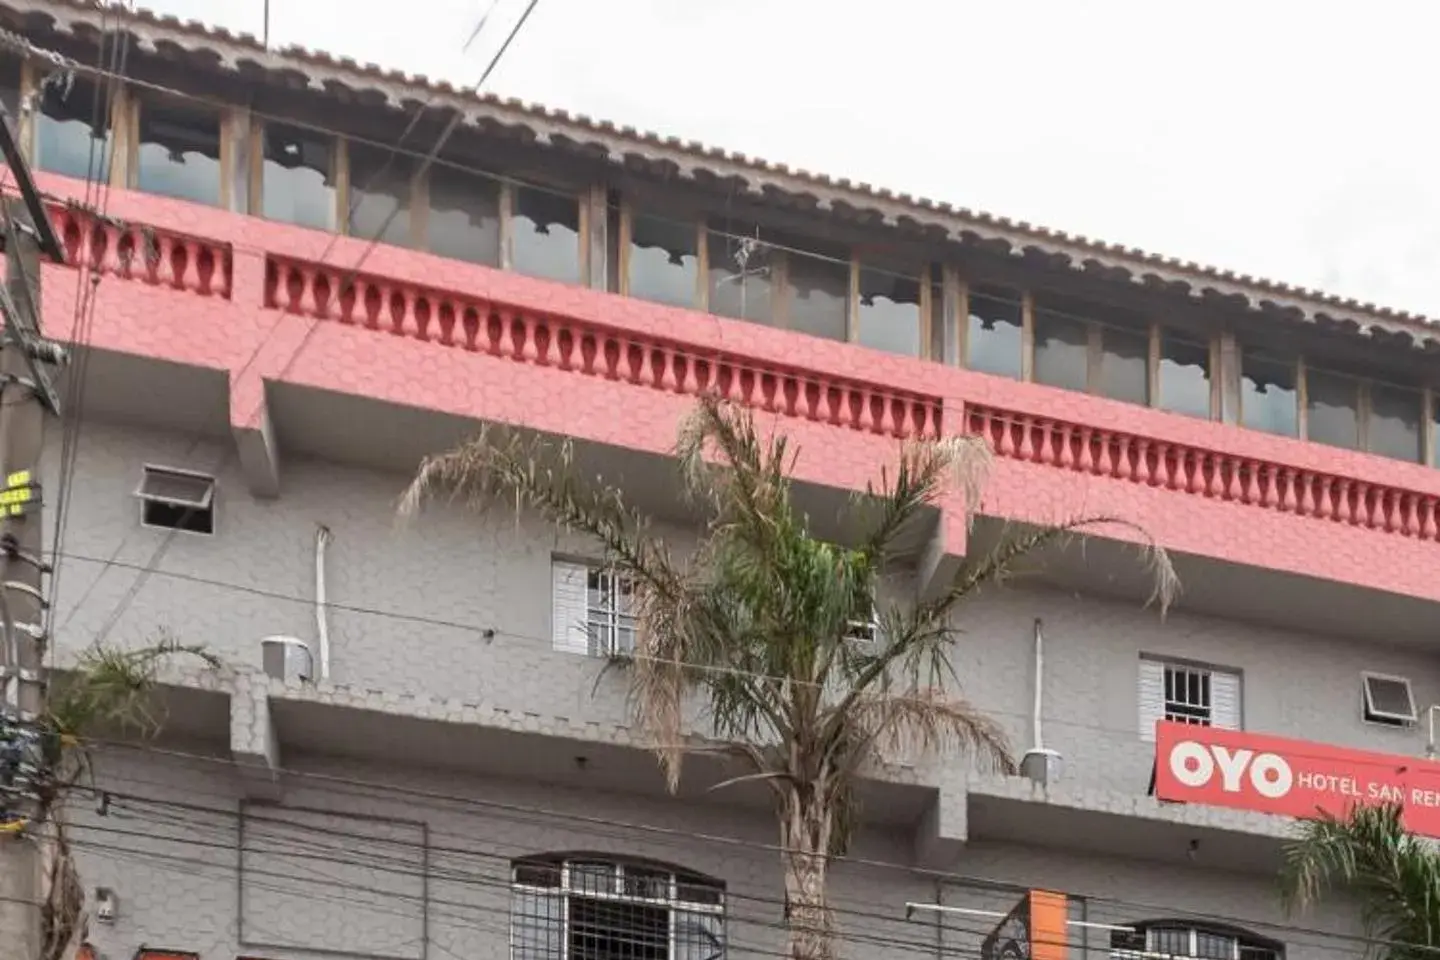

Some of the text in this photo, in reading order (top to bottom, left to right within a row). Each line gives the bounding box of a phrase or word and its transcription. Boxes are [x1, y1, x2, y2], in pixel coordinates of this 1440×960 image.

[1169, 740, 1293, 798] OYO
[1298, 771, 1363, 797] HOTEL
[1367, 781, 1406, 803] SAN
